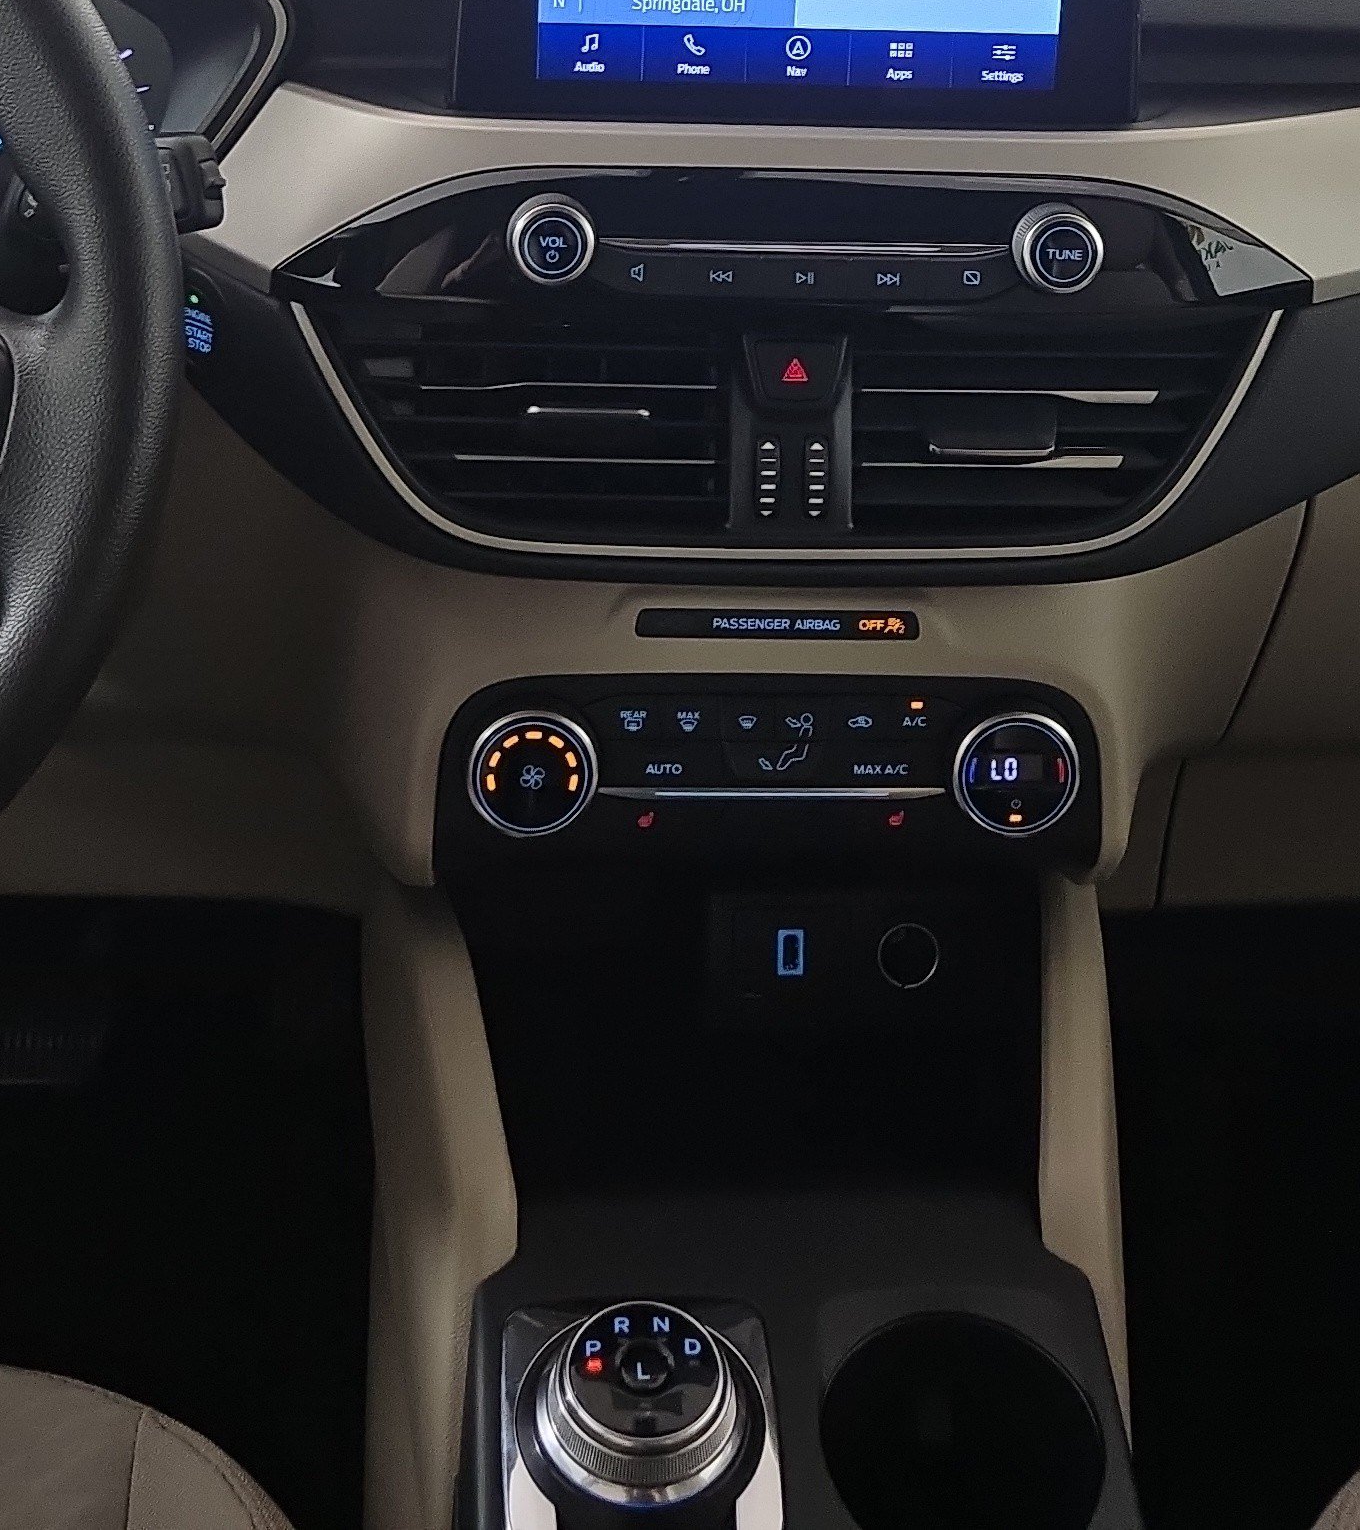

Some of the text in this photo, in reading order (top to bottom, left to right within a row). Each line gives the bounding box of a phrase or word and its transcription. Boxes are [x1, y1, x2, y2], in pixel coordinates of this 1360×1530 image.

[573, 60, 605, 74] Audio
[676, 63, 710, 76] Phone
[785, 65, 808, 78] Nav
[885, 68, 914, 82] Apps
[980, 70, 1024, 85] Settings
[539, 235, 568, 248] VOL
[1045, 248, 1084, 261] TUNE
[185, 325, 213, 343] START
[187, 337, 212, 354] STOP
[712, 617, 885, 632] PASSENGER AIRBAG OFF
[619, 710, 648, 720] REAR
[676, 710, 701, 720] MAX
[901, 716, 928, 728] A/C
[645, 762, 684, 775] AUTO
[853, 763, 910, 776] MAX A/C
[613, 1316, 631, 1335] R
[652, 1316, 671, 1333] N
[584, 1339, 602, 1357] P
[683, 1337, 702, 1356] D
[636, 1361, 652, 1380] L
